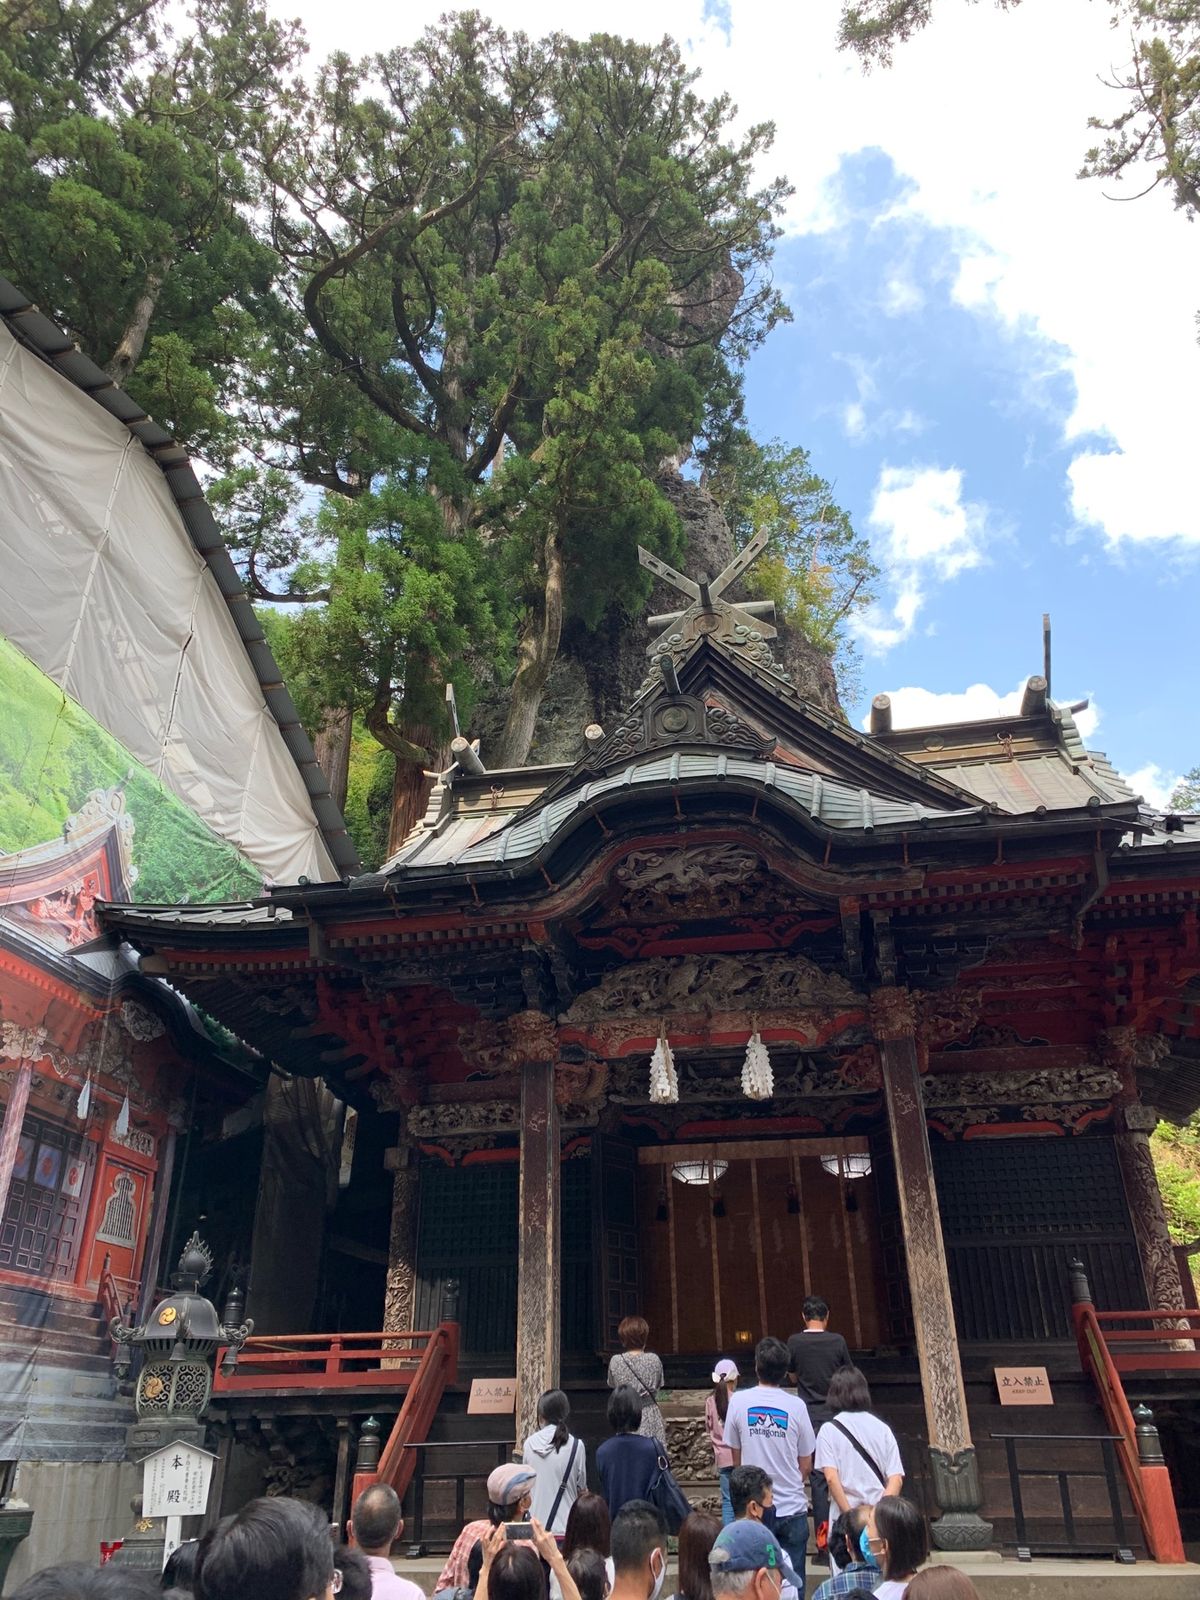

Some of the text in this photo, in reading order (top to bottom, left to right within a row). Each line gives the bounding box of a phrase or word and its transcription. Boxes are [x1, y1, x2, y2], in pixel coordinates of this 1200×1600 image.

[1001, 1375, 1045, 1387] 立入禁止
[474, 1386, 512, 1398] 立入禁止
[749, 1428, 786, 1438] patagonia
[167, 1454, 183, 1504] 本殿
